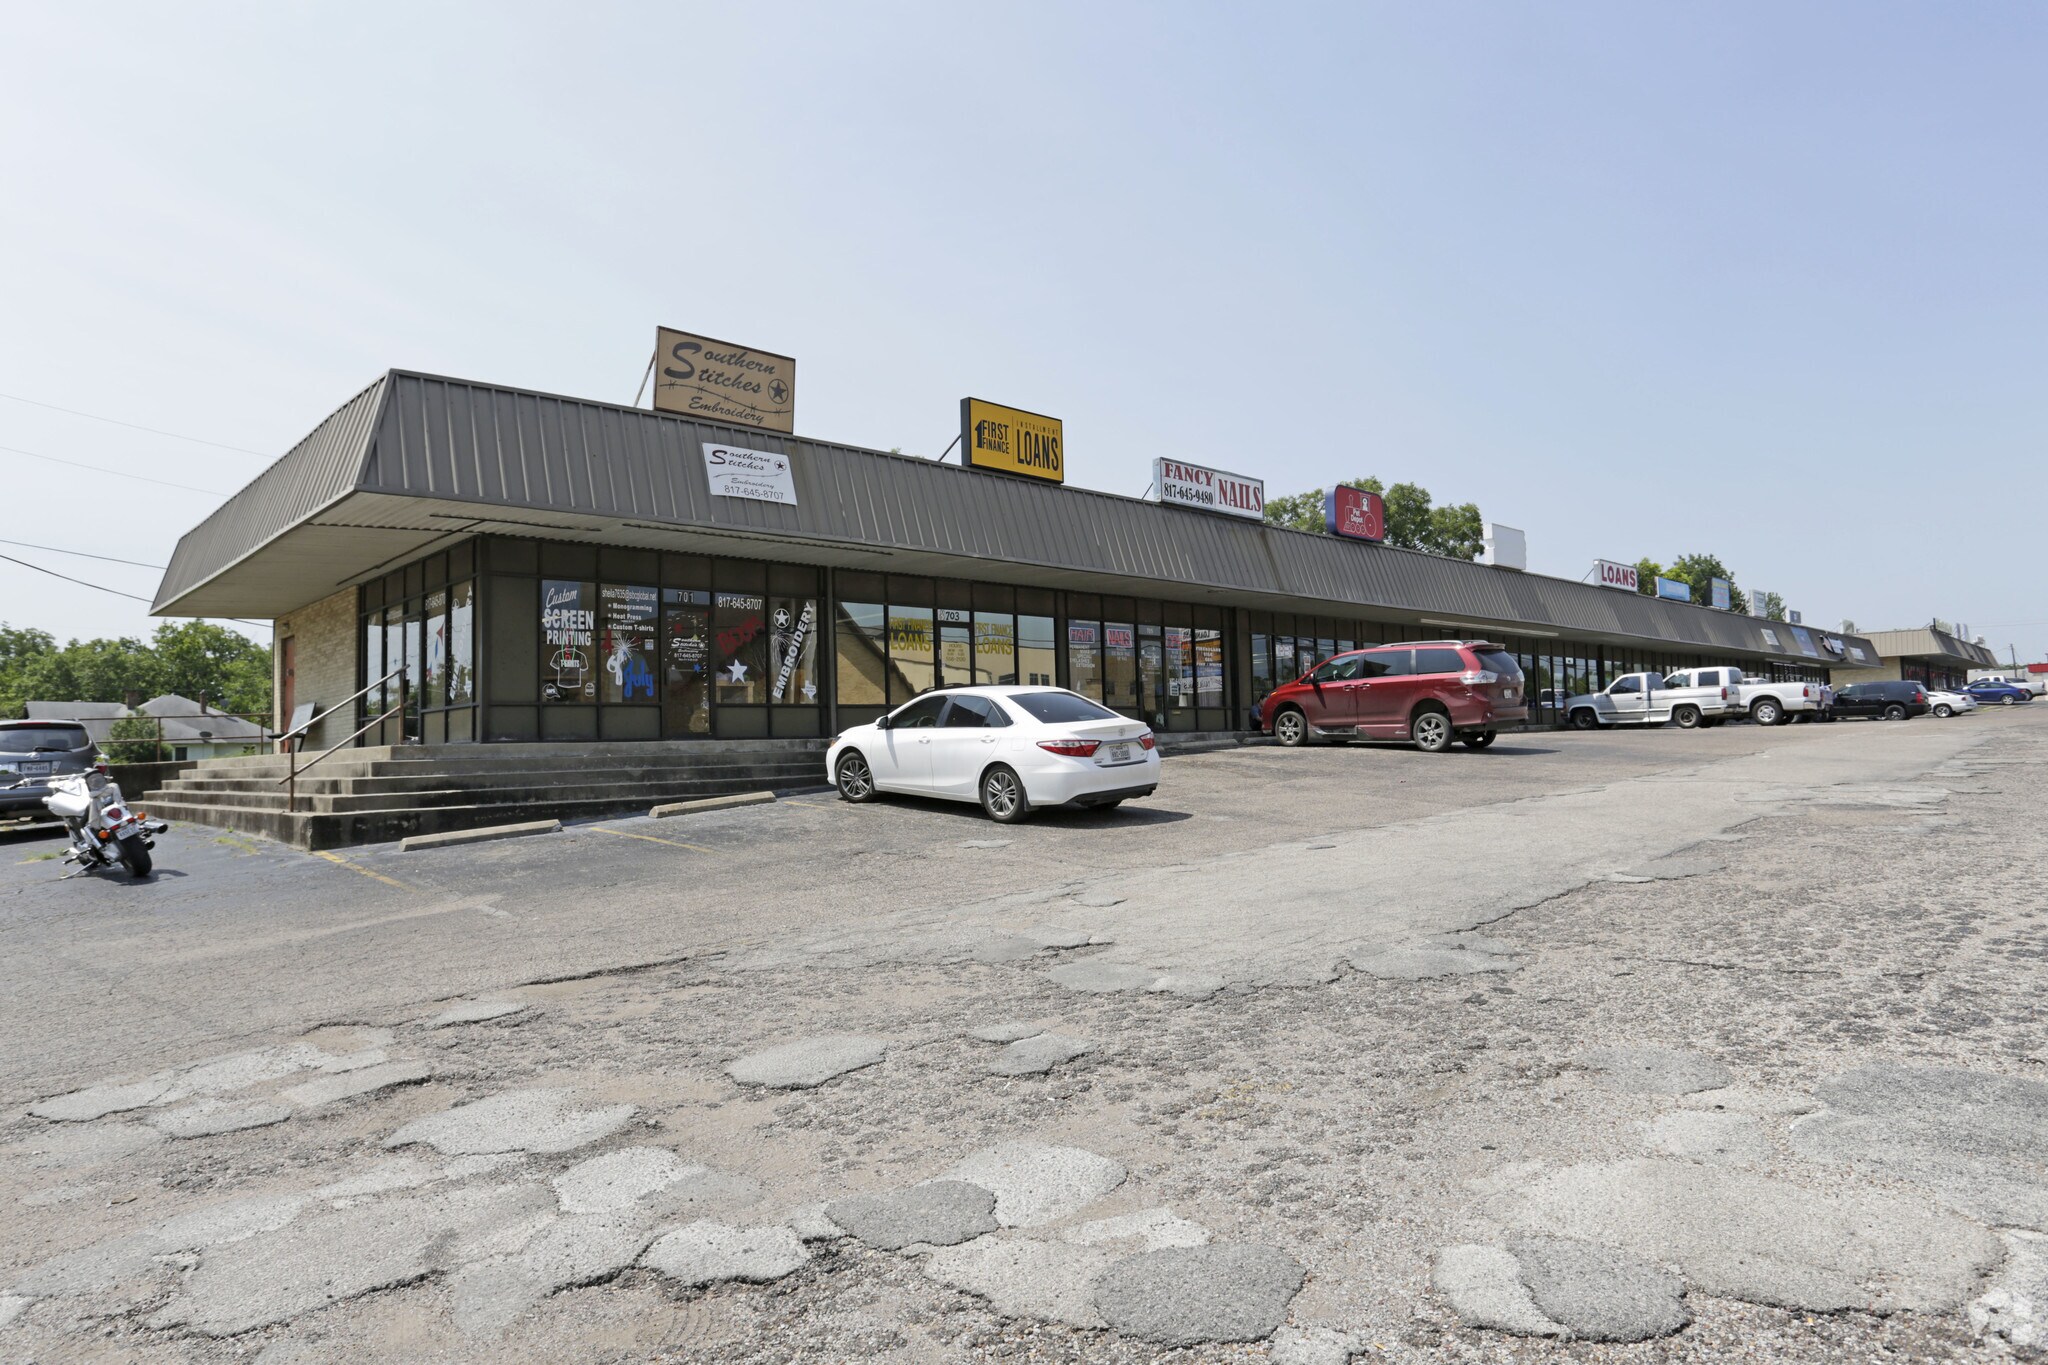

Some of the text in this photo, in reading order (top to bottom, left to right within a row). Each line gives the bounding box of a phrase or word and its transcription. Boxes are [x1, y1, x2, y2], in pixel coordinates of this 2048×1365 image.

[664, 342, 775, 379] Southern
[688, 396, 765, 425] Embroidery
[982, 420, 1009, 441] FIRST
[982, 437, 1010, 454] FINANCE
[1017, 429, 1059, 471] LOANS
[709, 449, 771, 465] Southern
[1164, 462, 1213, 487] FANCY
[731, 477, 775, 490] Embroidery
[724, 485, 784, 500] 817-645-8707
[1164, 482, 1213, 505] 817-645-9480
[1218, 478, 1261, 512] NAILS
[1601, 563, 1636, 588] LOANS
[545, 587, 577, 608] Custom
[677, 591, 694, 603] 701
[718, 596, 763, 610] 817-645-8707
[612, 602, 653, 612] Monogramming
[543, 608, 594, 630] SCREEN
[626, 613, 642, 621] Press
[945, 611, 960, 621] 703
[634, 624, 654, 632] T-shirts
[975, 622, 990, 635] FIRST
[1070, 629, 1093, 641] HAIR
[1107, 629, 1131, 642] NAILS
[546, 630, 592, 646] PRINTING
[890, 631, 932, 652] LOANS
[976, 636, 1013, 655] LOANS
[772, 601, 815, 700] EMBROIDERY
